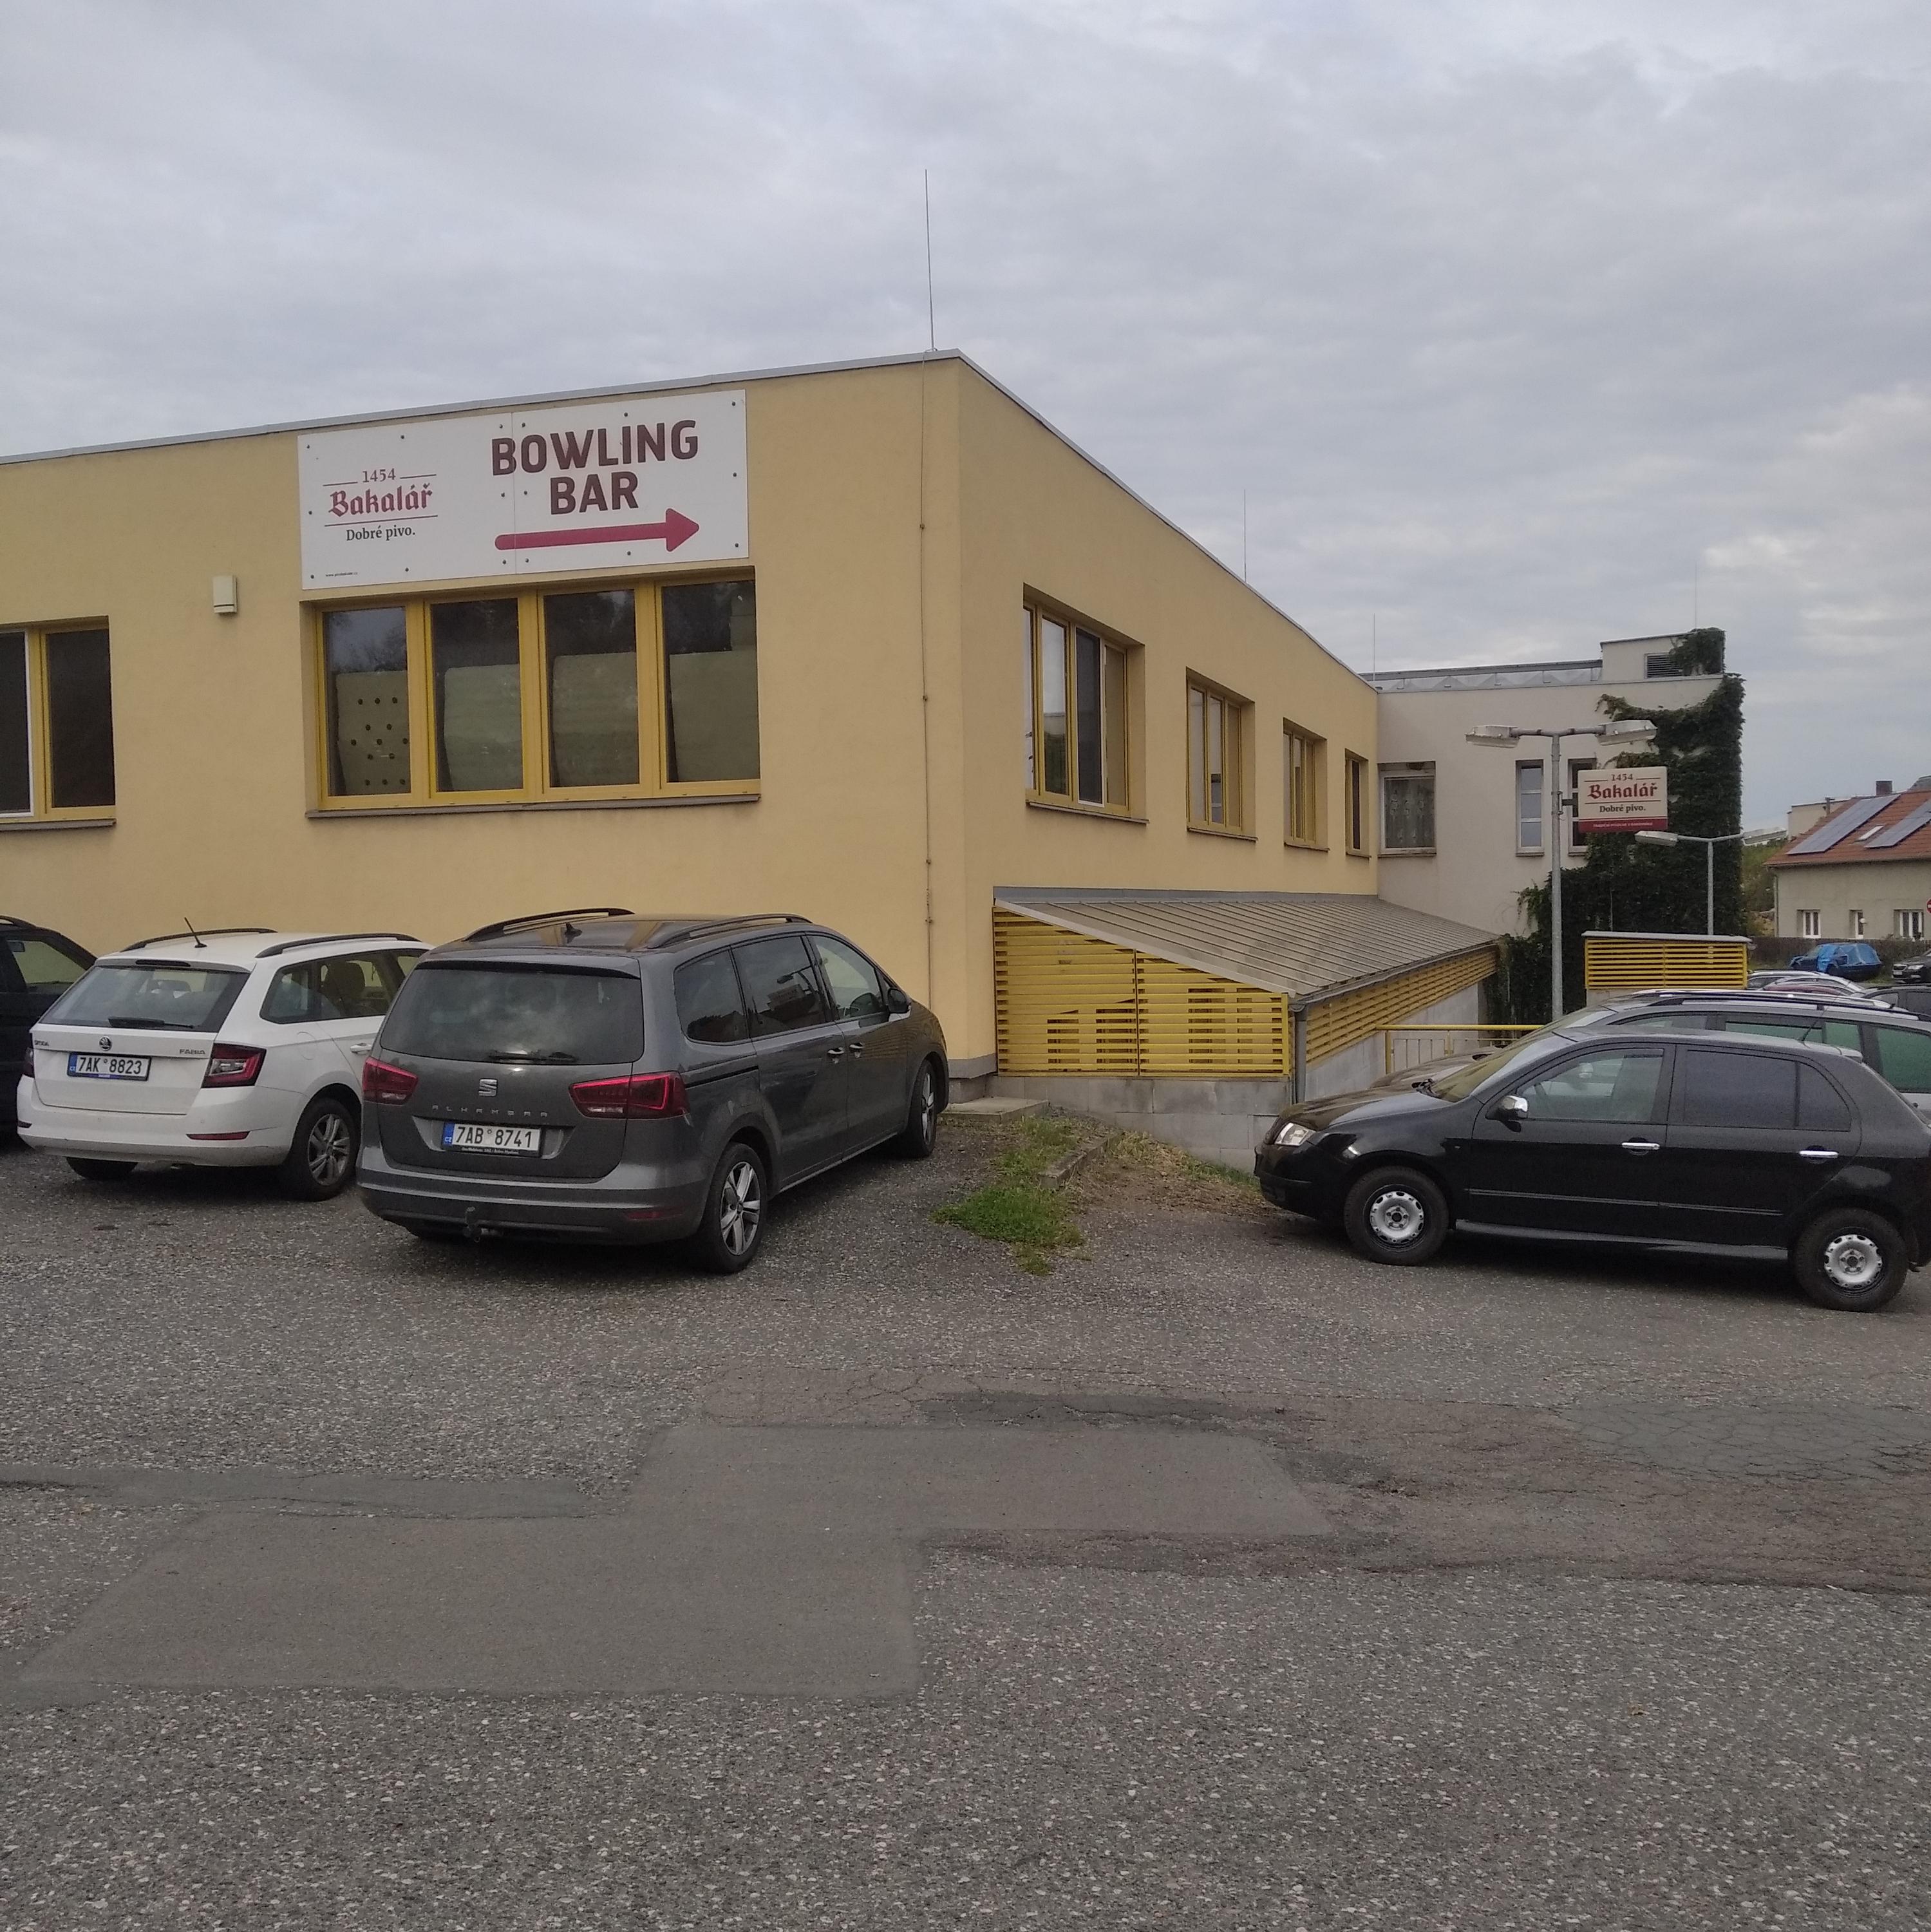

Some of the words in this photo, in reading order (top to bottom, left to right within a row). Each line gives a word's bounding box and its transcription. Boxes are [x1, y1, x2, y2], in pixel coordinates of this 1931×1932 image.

[491, 419, 699, 477] BOWLING
[362, 468, 396, 483] 1454
[328, 483, 433, 517] Bakalář
[549, 471, 639, 515] BAR
[346, 526, 382, 541] Dobré
[386, 525, 415, 541] pivo.
[1587, 782, 1658, 799] Bakalář
[1599, 804, 1624, 813] Dobré
[1626, 805, 1646, 813] pivo.
[78, 1057, 100, 1073] 7AK
[109, 1059, 142, 1075] 8823
[456, 1126, 484, 1144] 7AB
[495, 1129, 532, 1148] 8741
